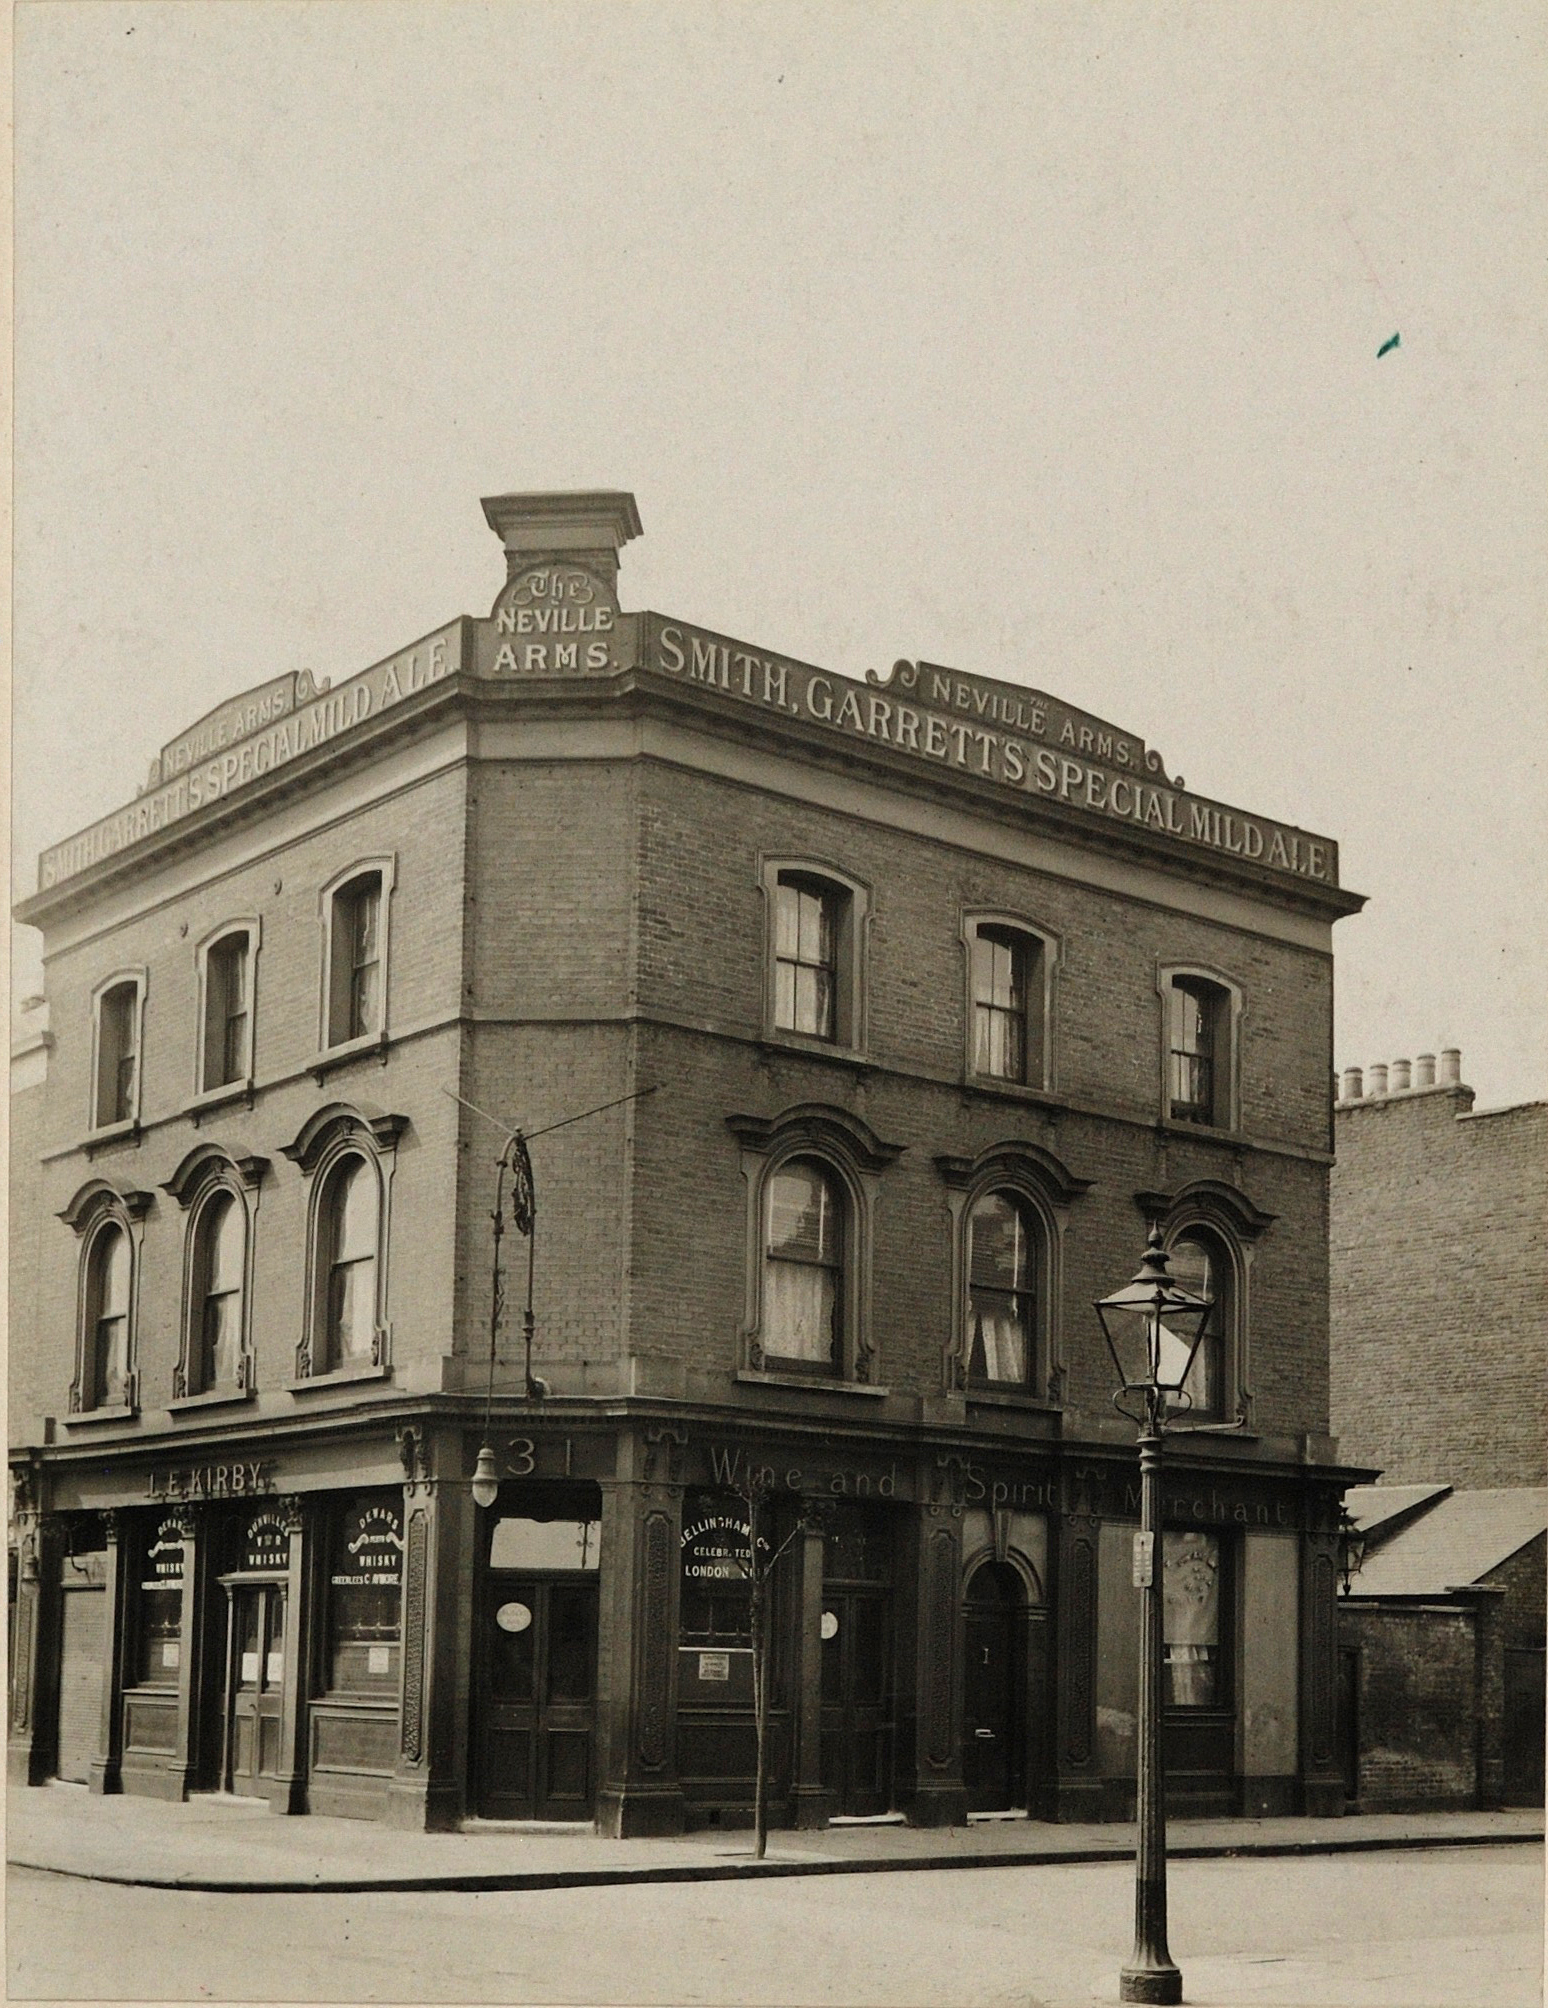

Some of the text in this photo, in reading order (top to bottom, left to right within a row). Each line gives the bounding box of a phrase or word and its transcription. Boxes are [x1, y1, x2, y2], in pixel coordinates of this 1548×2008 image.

[513, 570, 594, 605] The
[496, 607, 614, 634] NEVILLE
[933, 674, 1046, 735] NEVILLE
[164, 721, 227, 777] NEVILLE
[207, 719, 307, 799] SPECIAL
[312, 684, 372, 745] MILD
[1036, 750, 1184, 834] SPECIAL
[1190, 802, 1264, 858] MILD
[711, 1446, 1288, 1525] Wine and Spirit Mrchant
[249, 1553, 287, 1565] WHISKY
[359, 1554, 396, 1567] WHISKY
[693, 1546, 751, 1558] CELEBRTED
[685, 1565, 729, 1578] LONDON
